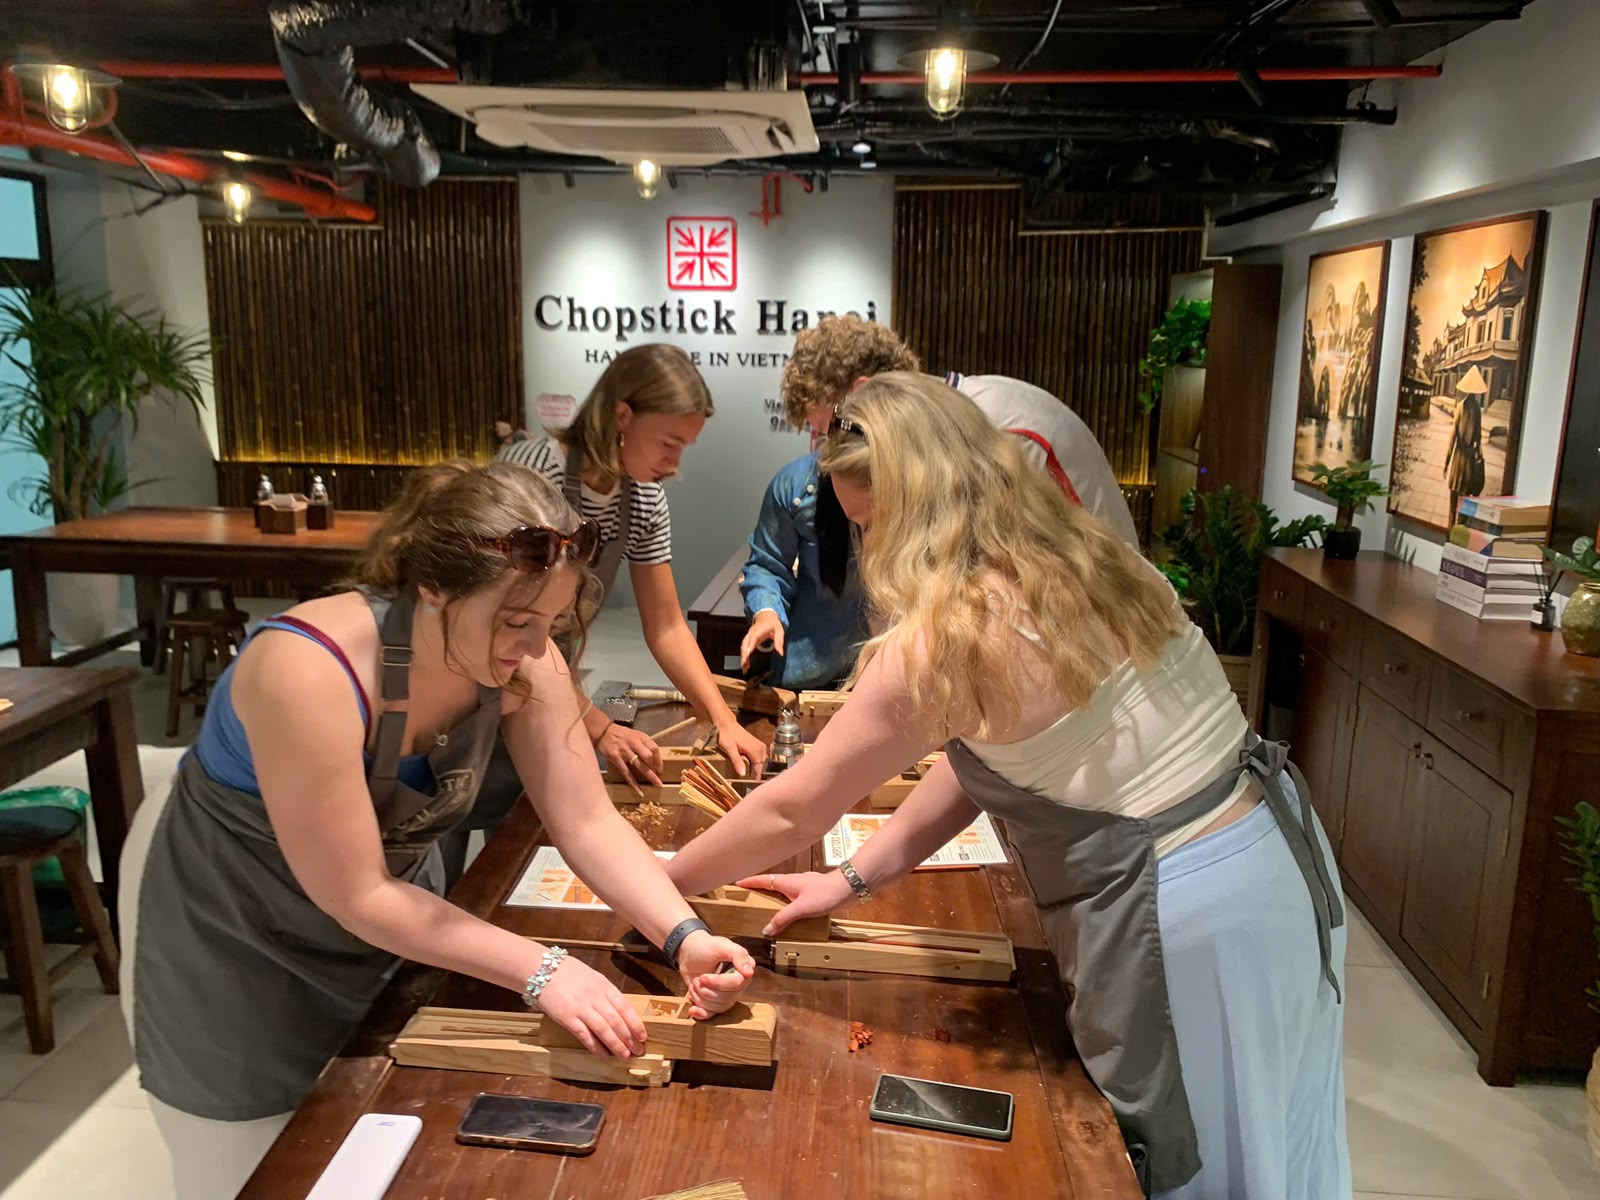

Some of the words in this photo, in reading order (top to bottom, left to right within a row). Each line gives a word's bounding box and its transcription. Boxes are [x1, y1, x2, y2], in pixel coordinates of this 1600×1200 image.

[534, 295, 737, 342] Chopstick
[756, 300, 877, 336] Hai
[710, 352, 729, 367] IN
